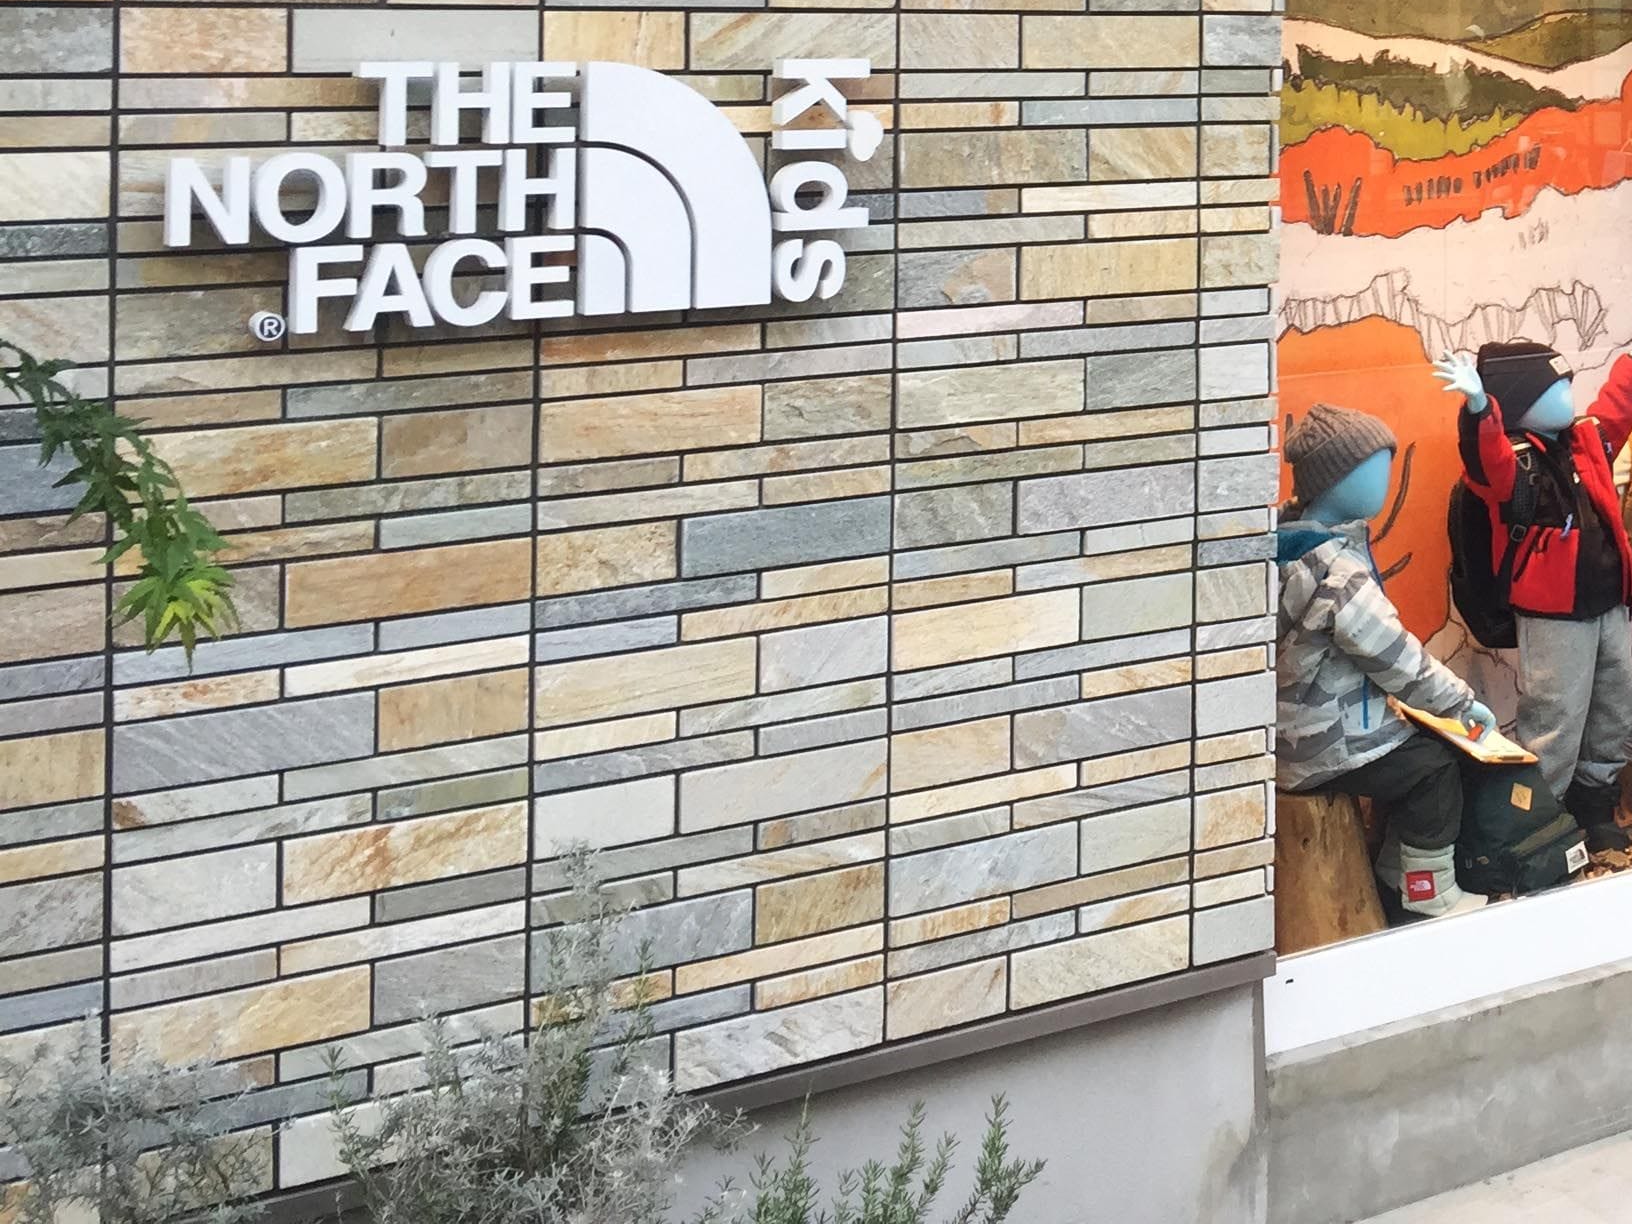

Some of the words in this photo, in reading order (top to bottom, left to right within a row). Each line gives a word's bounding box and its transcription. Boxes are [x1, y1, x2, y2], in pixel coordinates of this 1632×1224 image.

[352, 61, 577, 146] THE
[163, 147, 577, 247] NORTH
[771, 58, 883, 302] kids
[287, 235, 577, 335] FACE
